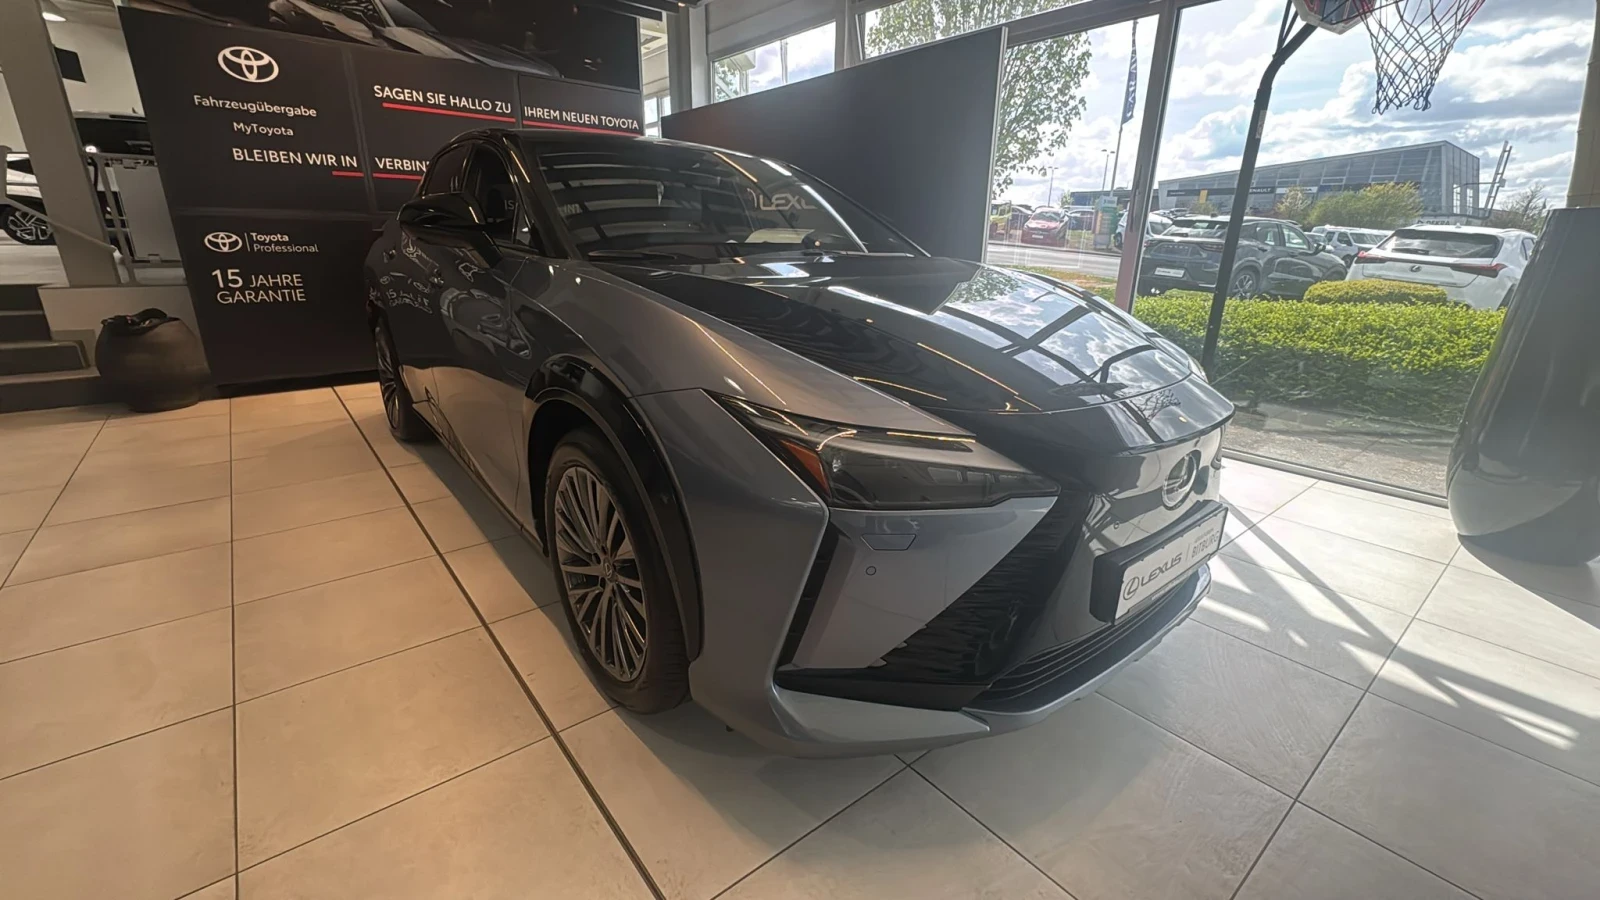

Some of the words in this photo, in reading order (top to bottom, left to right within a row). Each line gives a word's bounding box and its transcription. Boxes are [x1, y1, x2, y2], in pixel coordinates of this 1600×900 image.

[193, 94, 317, 118] Fahrzeugübergabe
[373, 84, 424, 104] SAGEN
[426, 91, 448, 106] SIE
[449, 94, 493, 113] HALLO
[494, 100, 512, 114] ZU
[523, 105, 561, 121] IHREM
[562, 110, 599, 126] NEUEN
[599, 115, 640, 131] TOYOTA
[233, 121, 294, 138] MyToyota
[232, 147, 303, 166] BLEIBEN
[304, 152, 338, 167] WIR
[340, 154, 358, 169] IN
[249, 232, 289, 244] Toyota
[252, 243, 319, 253] Professional
[211, 268, 243, 288] 15
[249, 274, 304, 288] JAHRE
[216, 288, 307, 304] GARANTIE
[1140, 551, 1183, 588] LEXUS
